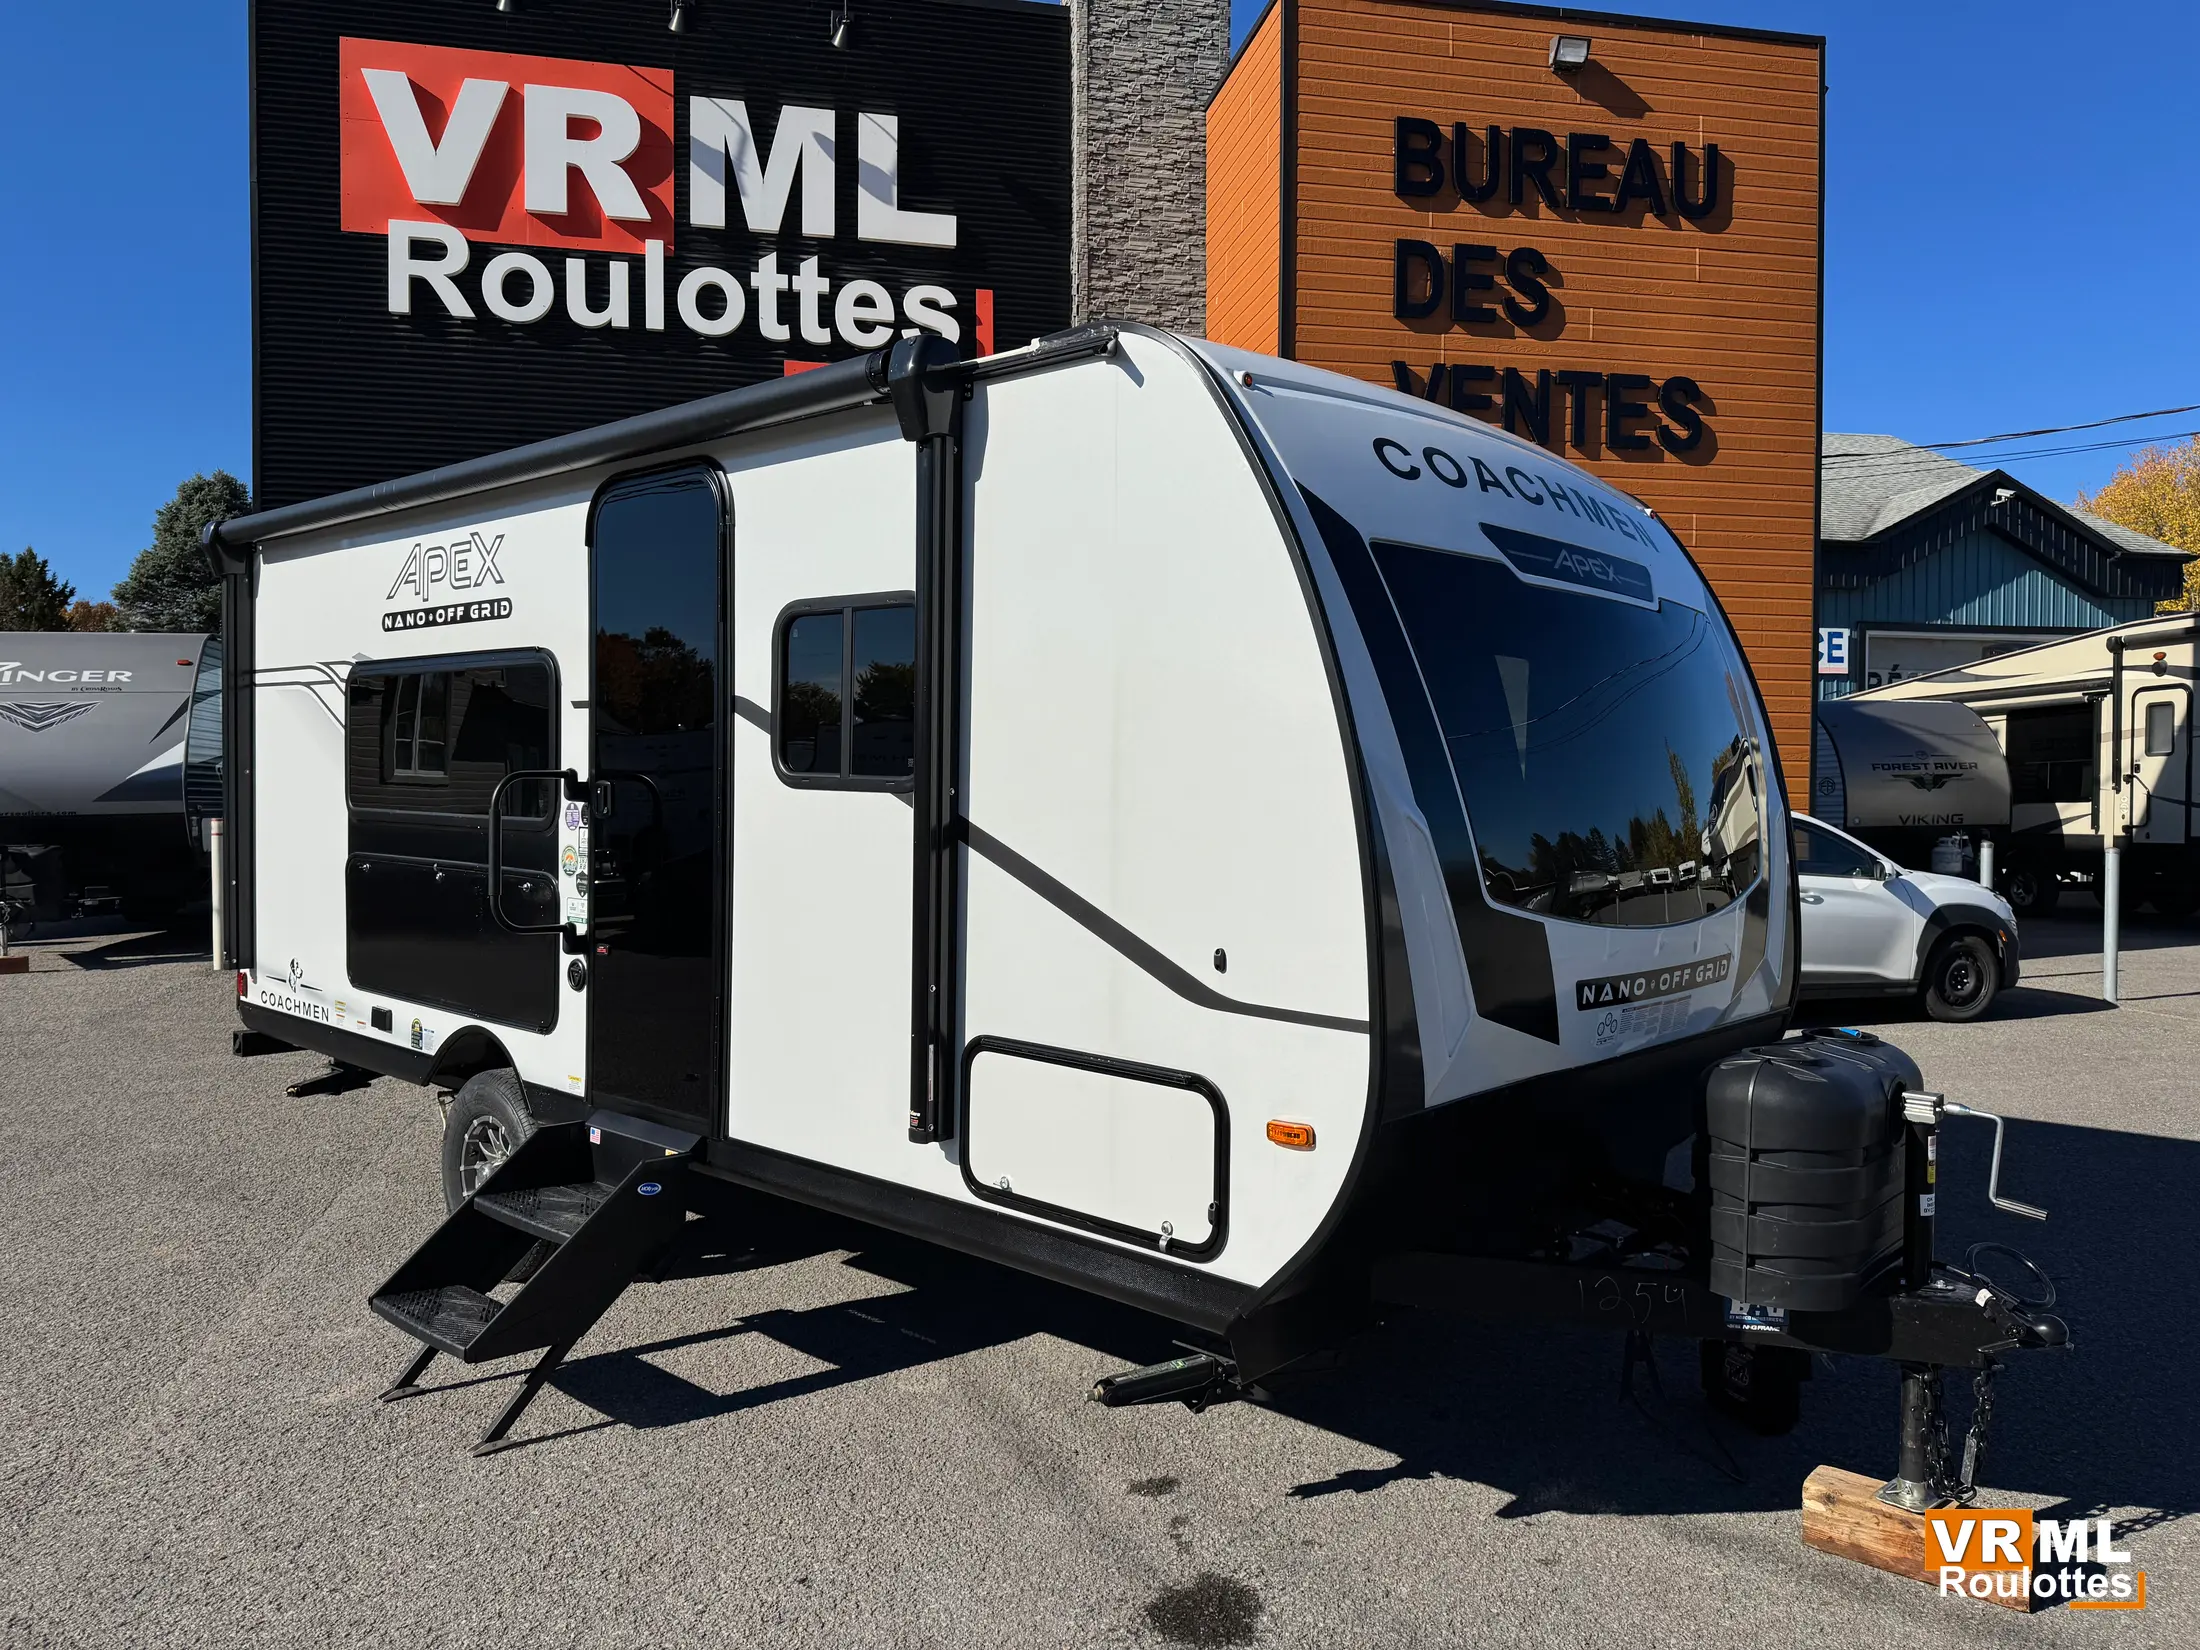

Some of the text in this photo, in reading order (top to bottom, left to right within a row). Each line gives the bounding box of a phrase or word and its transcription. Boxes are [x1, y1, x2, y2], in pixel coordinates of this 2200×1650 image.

[360, 67, 957, 249] VR ML
[1394, 116, 1718, 219] BUREAU
[387, 219, 960, 349] Roulottes
[1393, 238, 1550, 327] DES
[1372, 437, 1661, 553] COACHMEN
[386, 532, 505, 602] APEX
[1553, 549, 1622, 584] APEX
[384, 600, 510, 629] NANO OFF GRID
[1871, 761, 1978, 771] FOREST RIVER
[1899, 813, 1964, 825] VIKING
[260, 990, 329, 1022] COACHMEN
[1582, 958, 1729, 1005] NANO OFF GRID
